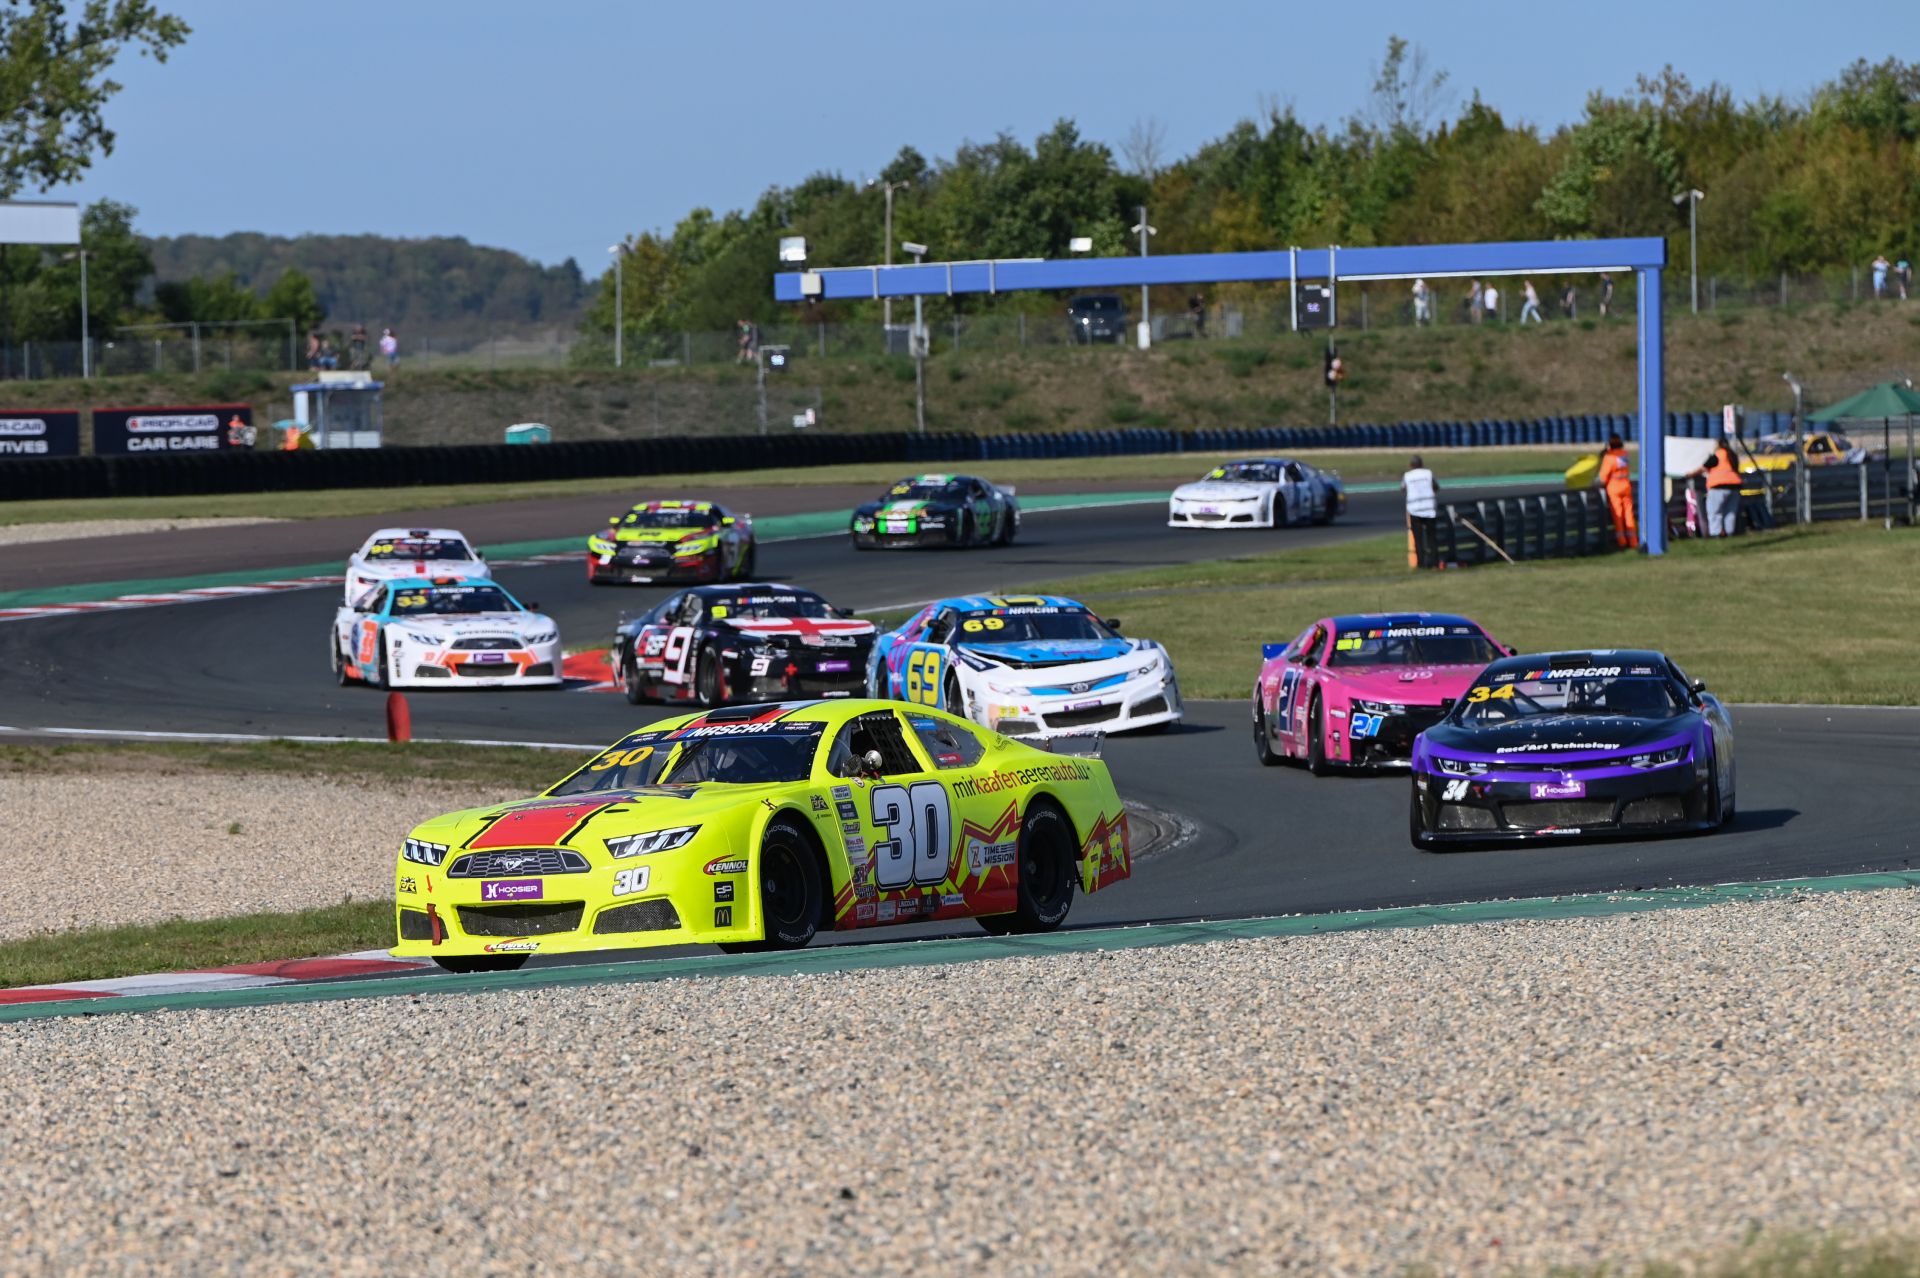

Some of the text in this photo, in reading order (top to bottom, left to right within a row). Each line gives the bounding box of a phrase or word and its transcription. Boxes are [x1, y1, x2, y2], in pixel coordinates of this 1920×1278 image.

[127, 436, 219, 451] CAR CARE
[397, 596, 428, 608] 33
[1009, 607, 1059, 616] NASCAR
[963, 618, 1005, 632] 69
[1388, 627, 1445, 637] NASCAR
[663, 626, 695, 684] 9
[750, 658, 770, 677] 9
[1547, 666, 1622, 679] NASCAR
[908, 650, 941, 704] 69
[1468, 684, 1516, 703] 34
[687, 722, 779, 738] NASCAR
[1349, 712, 1385, 739] 21
[1551, 741, 1620, 751] Technology
[590, 746, 655, 771] 30
[1441, 780, 1470, 801] 34
[870, 780, 952, 893] 30
[983, 844, 1001, 855] TIME
[707, 860, 747, 872] KENNOL
[983, 852, 1015, 865] MISSION
[613, 865, 650, 896] 30
[498, 885, 538, 893] HOOSIER
